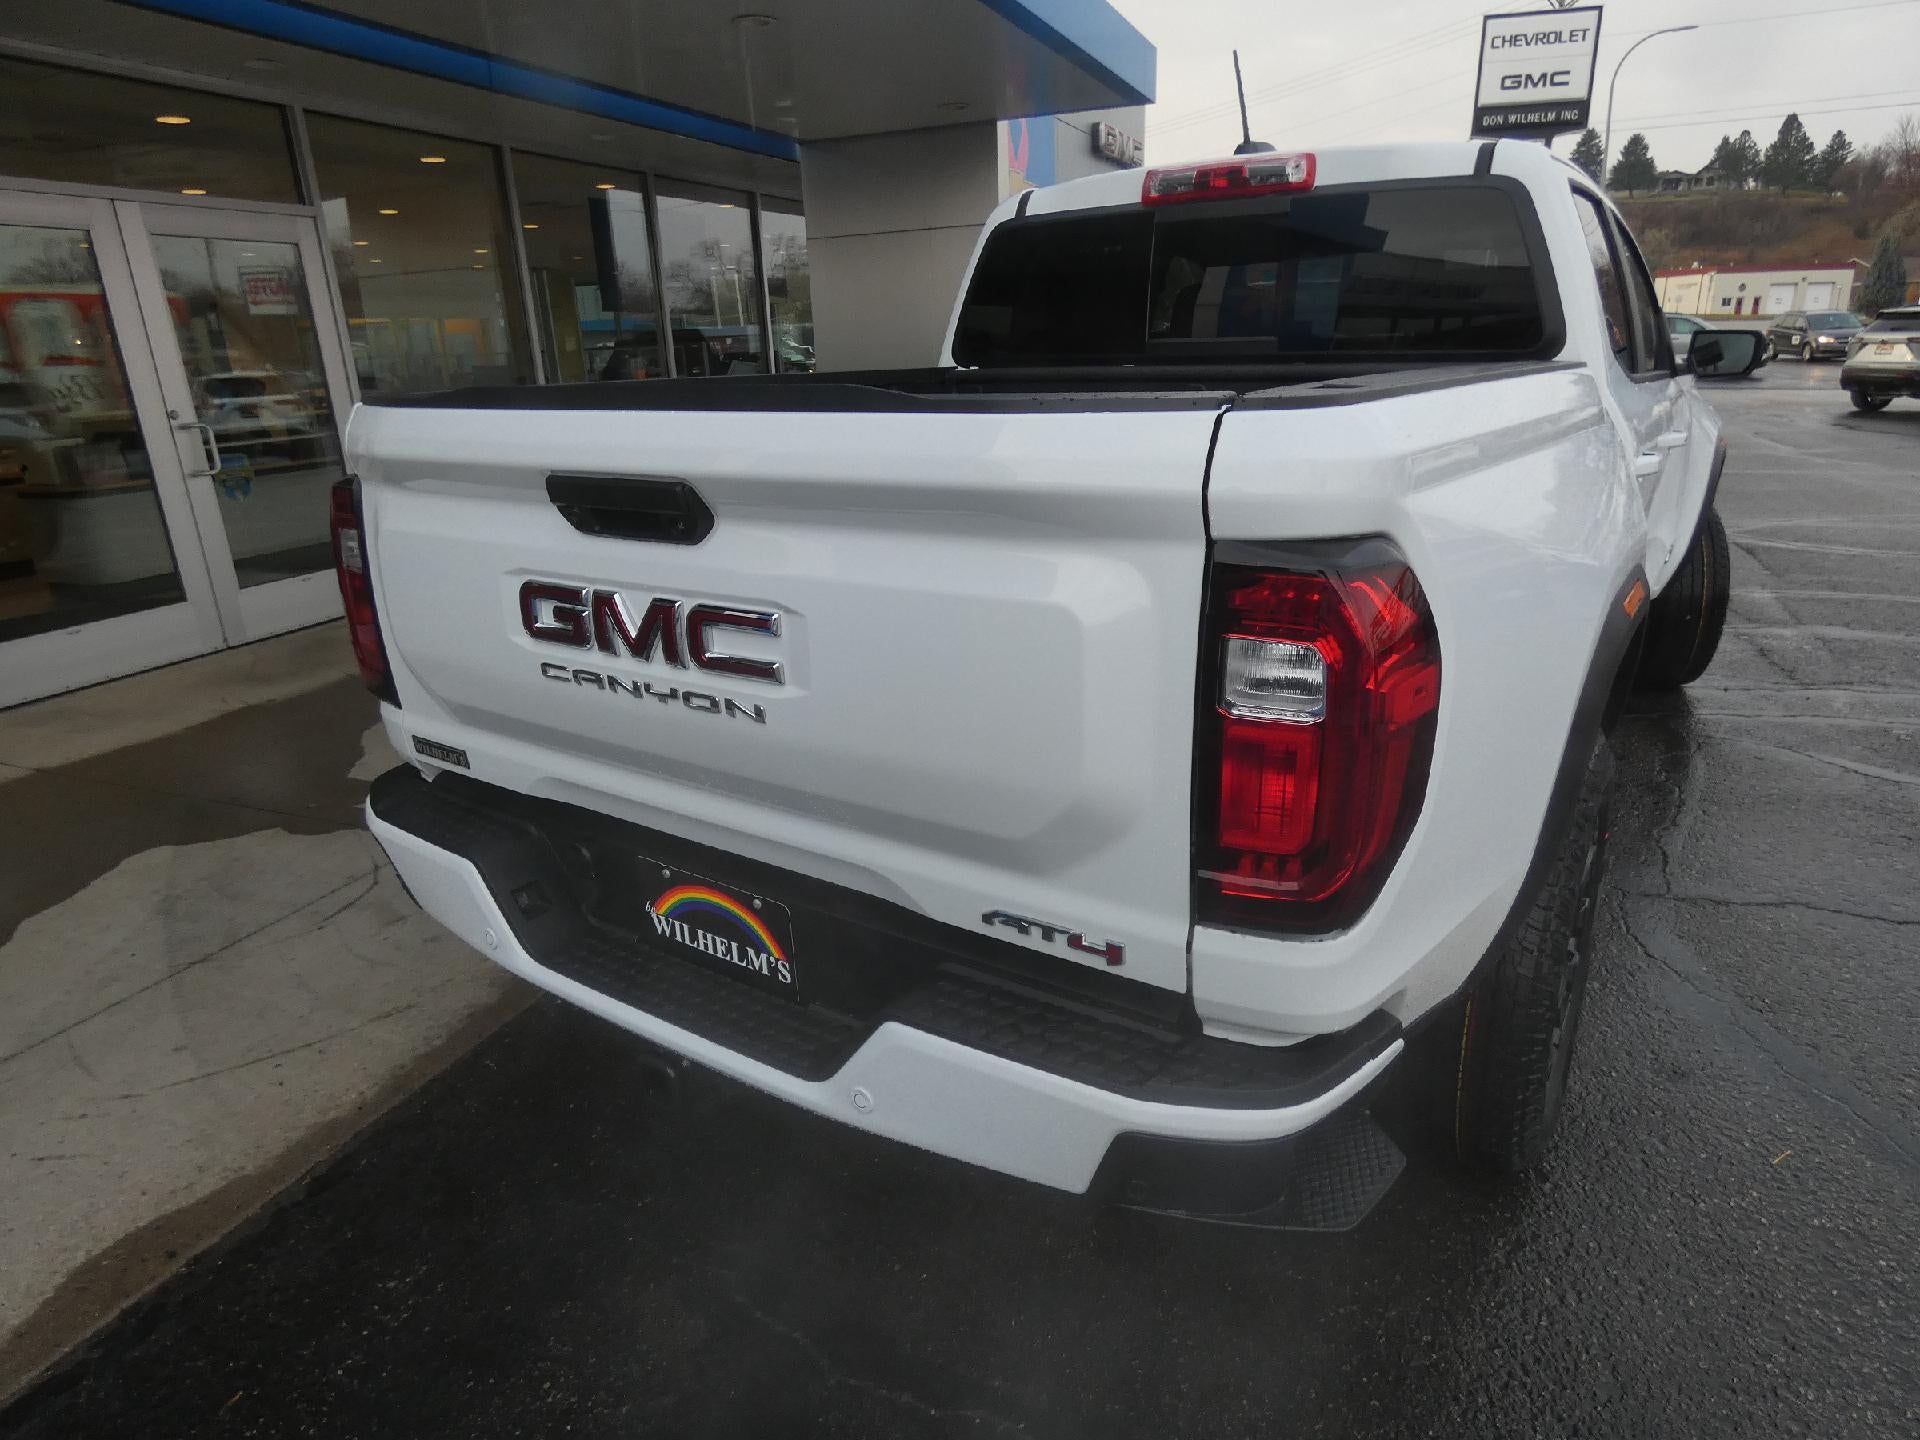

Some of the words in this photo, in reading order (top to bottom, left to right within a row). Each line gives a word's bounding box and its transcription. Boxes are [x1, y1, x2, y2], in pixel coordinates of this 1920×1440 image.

[1490, 28, 1590, 49] CHEVROLET
[1500, 70, 1571, 91] GMC
[1482, 114, 1503, 126] DON
[1507, 109, 1556, 123] WILHELM
[1560, 109, 1579, 121] INC
[518, 578, 786, 685] GMC
[540, 661, 767, 724] CANYON
[981, 909, 1127, 967] AT4
